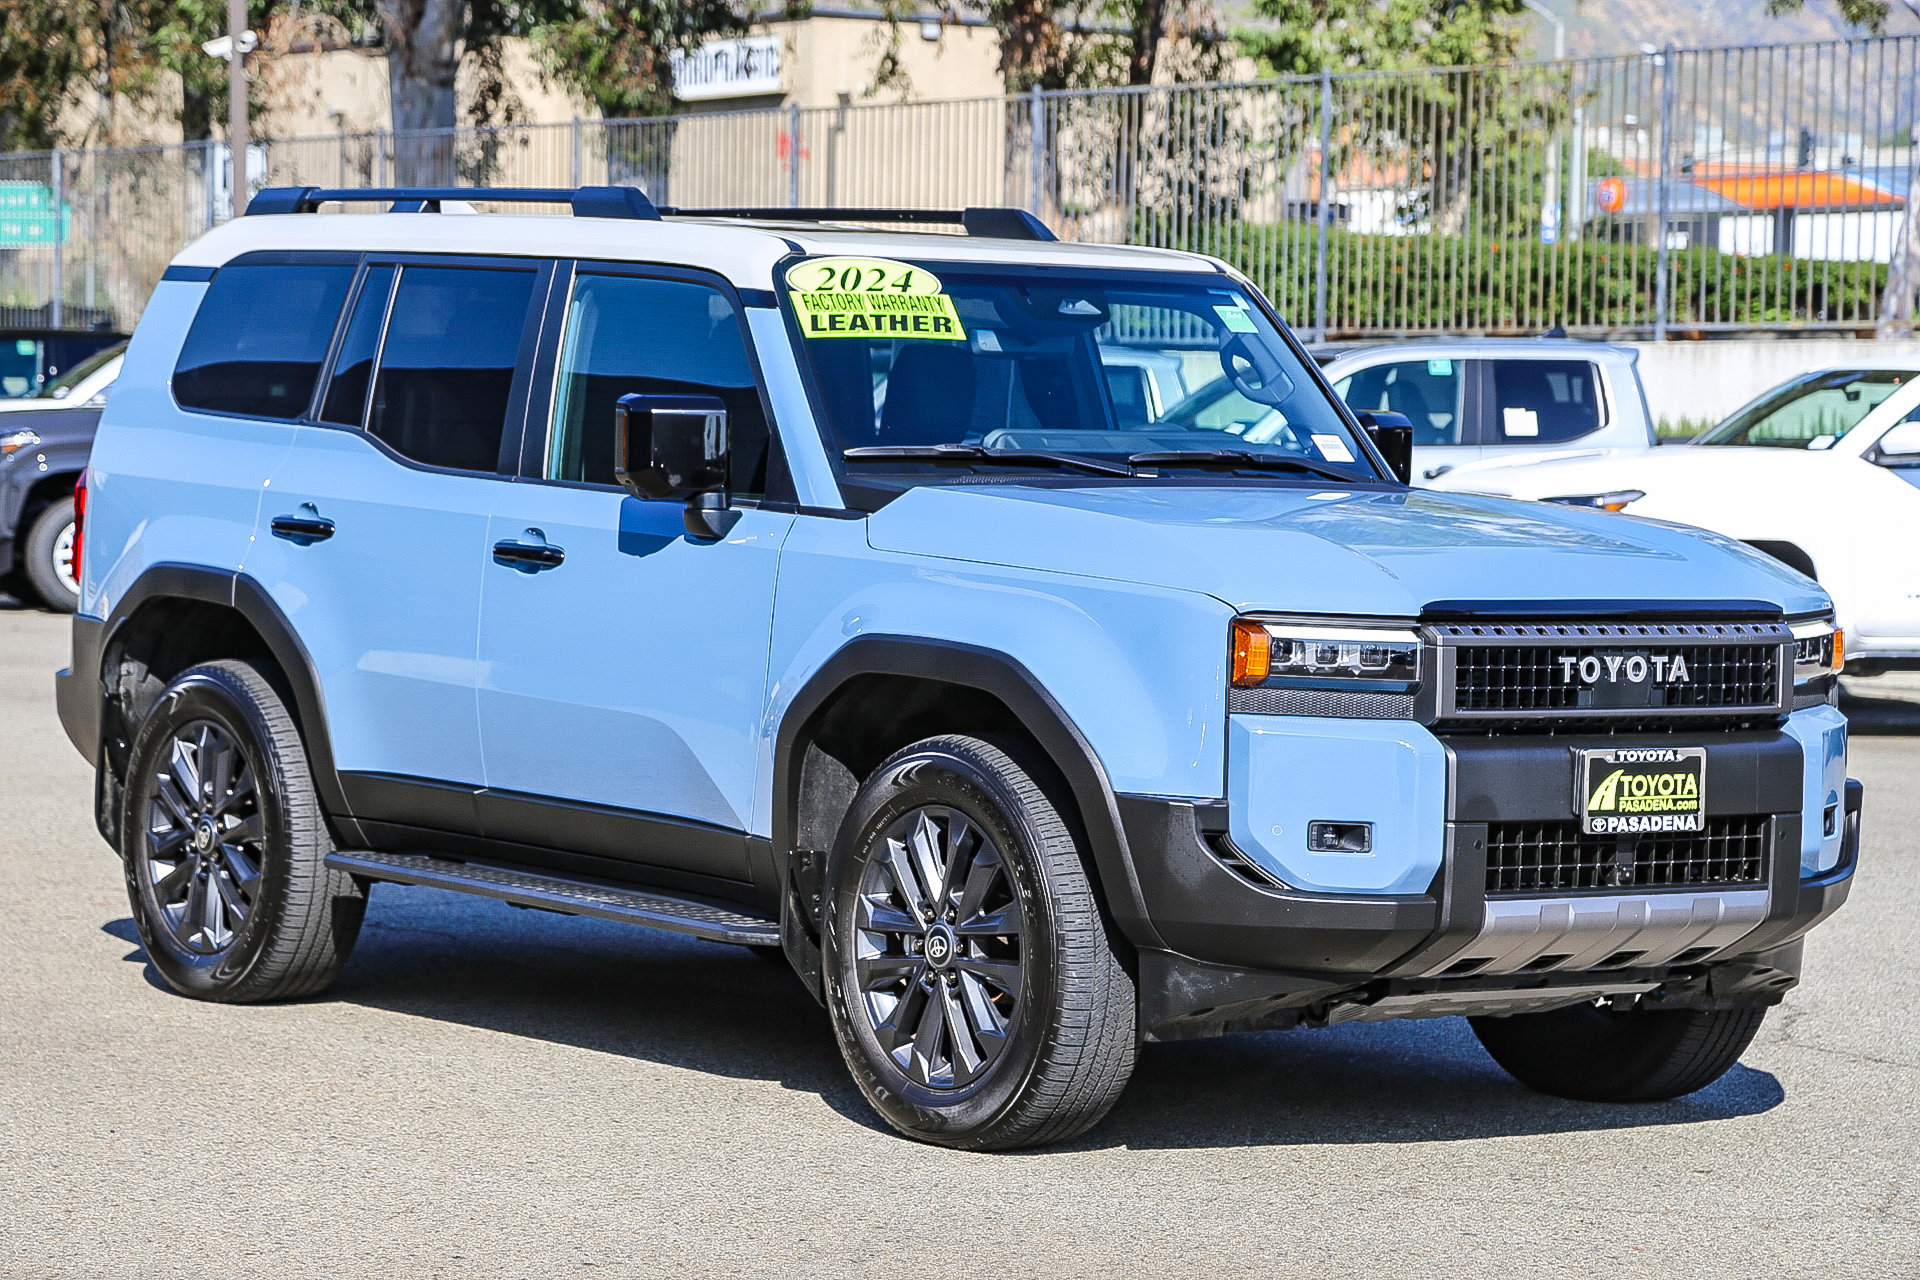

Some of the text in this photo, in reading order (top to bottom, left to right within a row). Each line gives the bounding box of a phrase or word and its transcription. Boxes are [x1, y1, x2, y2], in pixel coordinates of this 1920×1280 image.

[815, 267, 914, 293] 2024
[802, 293, 944, 314] FACTORY WARRANTY
[811, 313, 952, 333] LEATHER
[1559, 656, 1690, 683] TOYOTA
[1617, 750, 1675, 762] TOYOTA
[1619, 773, 1698, 797] TOYOTA
[1619, 799, 1698, 812] PASADENA.com
[1607, 815, 1697, 833] PASADENA
